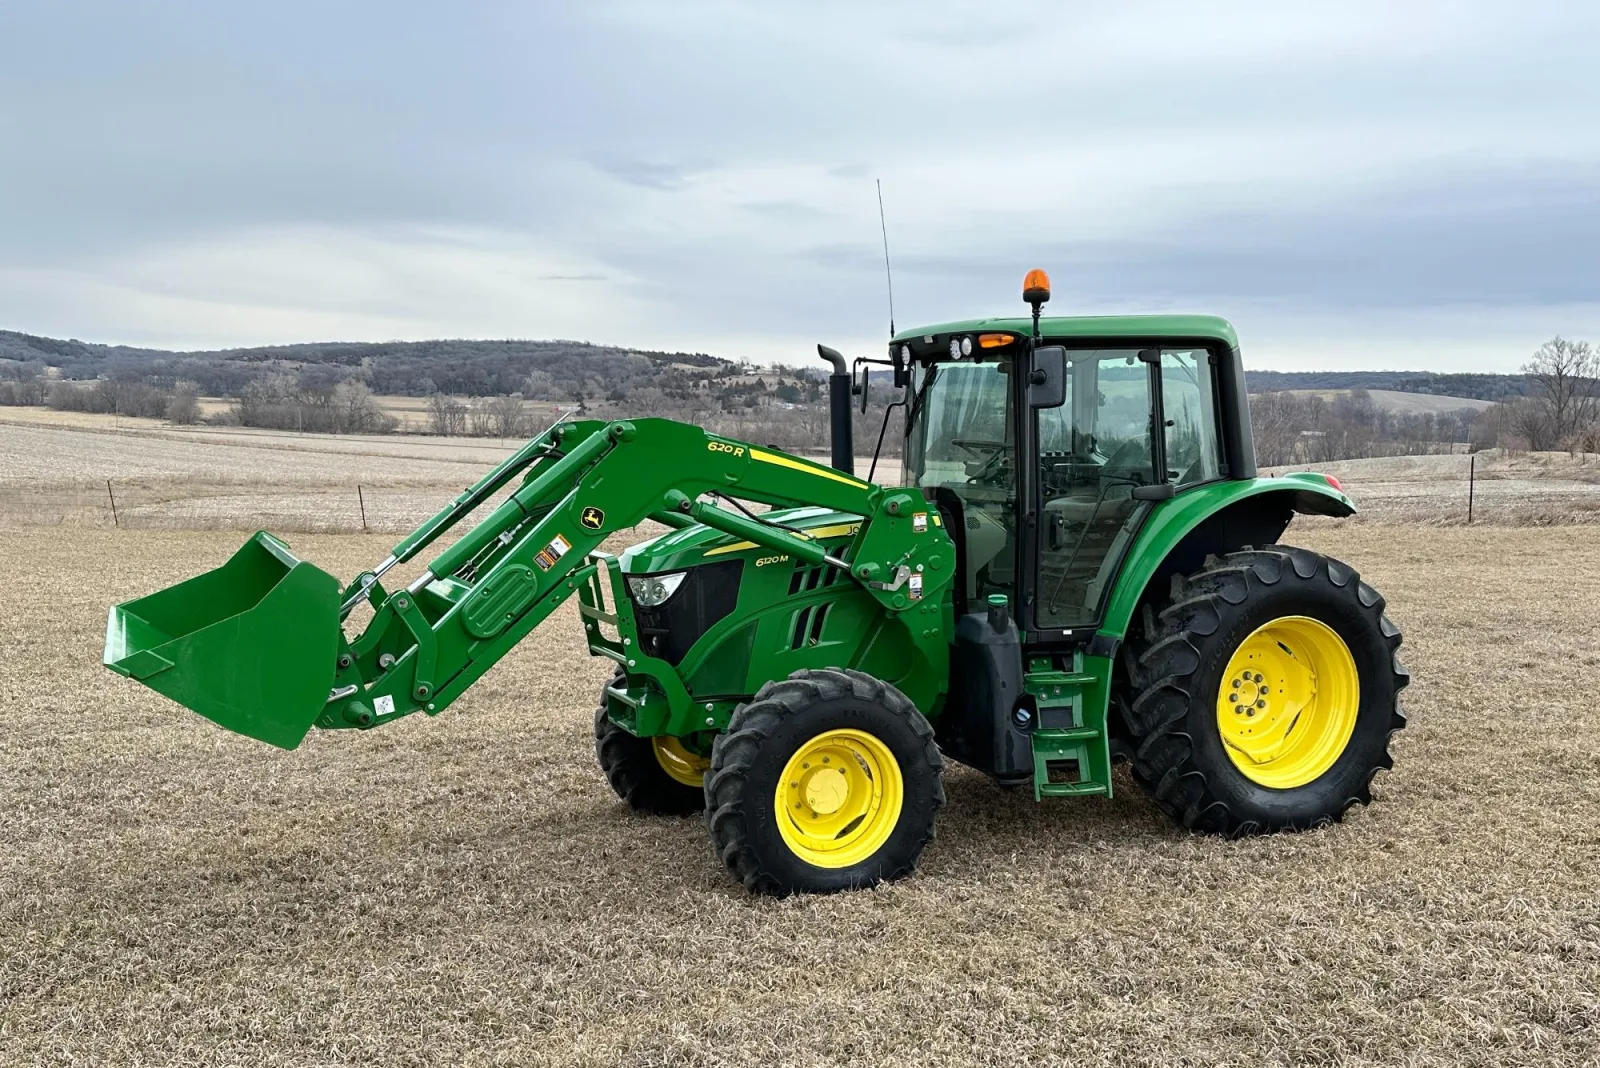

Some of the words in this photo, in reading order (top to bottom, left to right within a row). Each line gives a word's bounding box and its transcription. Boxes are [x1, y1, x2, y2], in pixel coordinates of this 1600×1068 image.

[707, 441, 733, 453] 620
[733, 447, 745, 458] R
[755, 556, 779, 567] 6120
[779, 555, 789, 563] M
